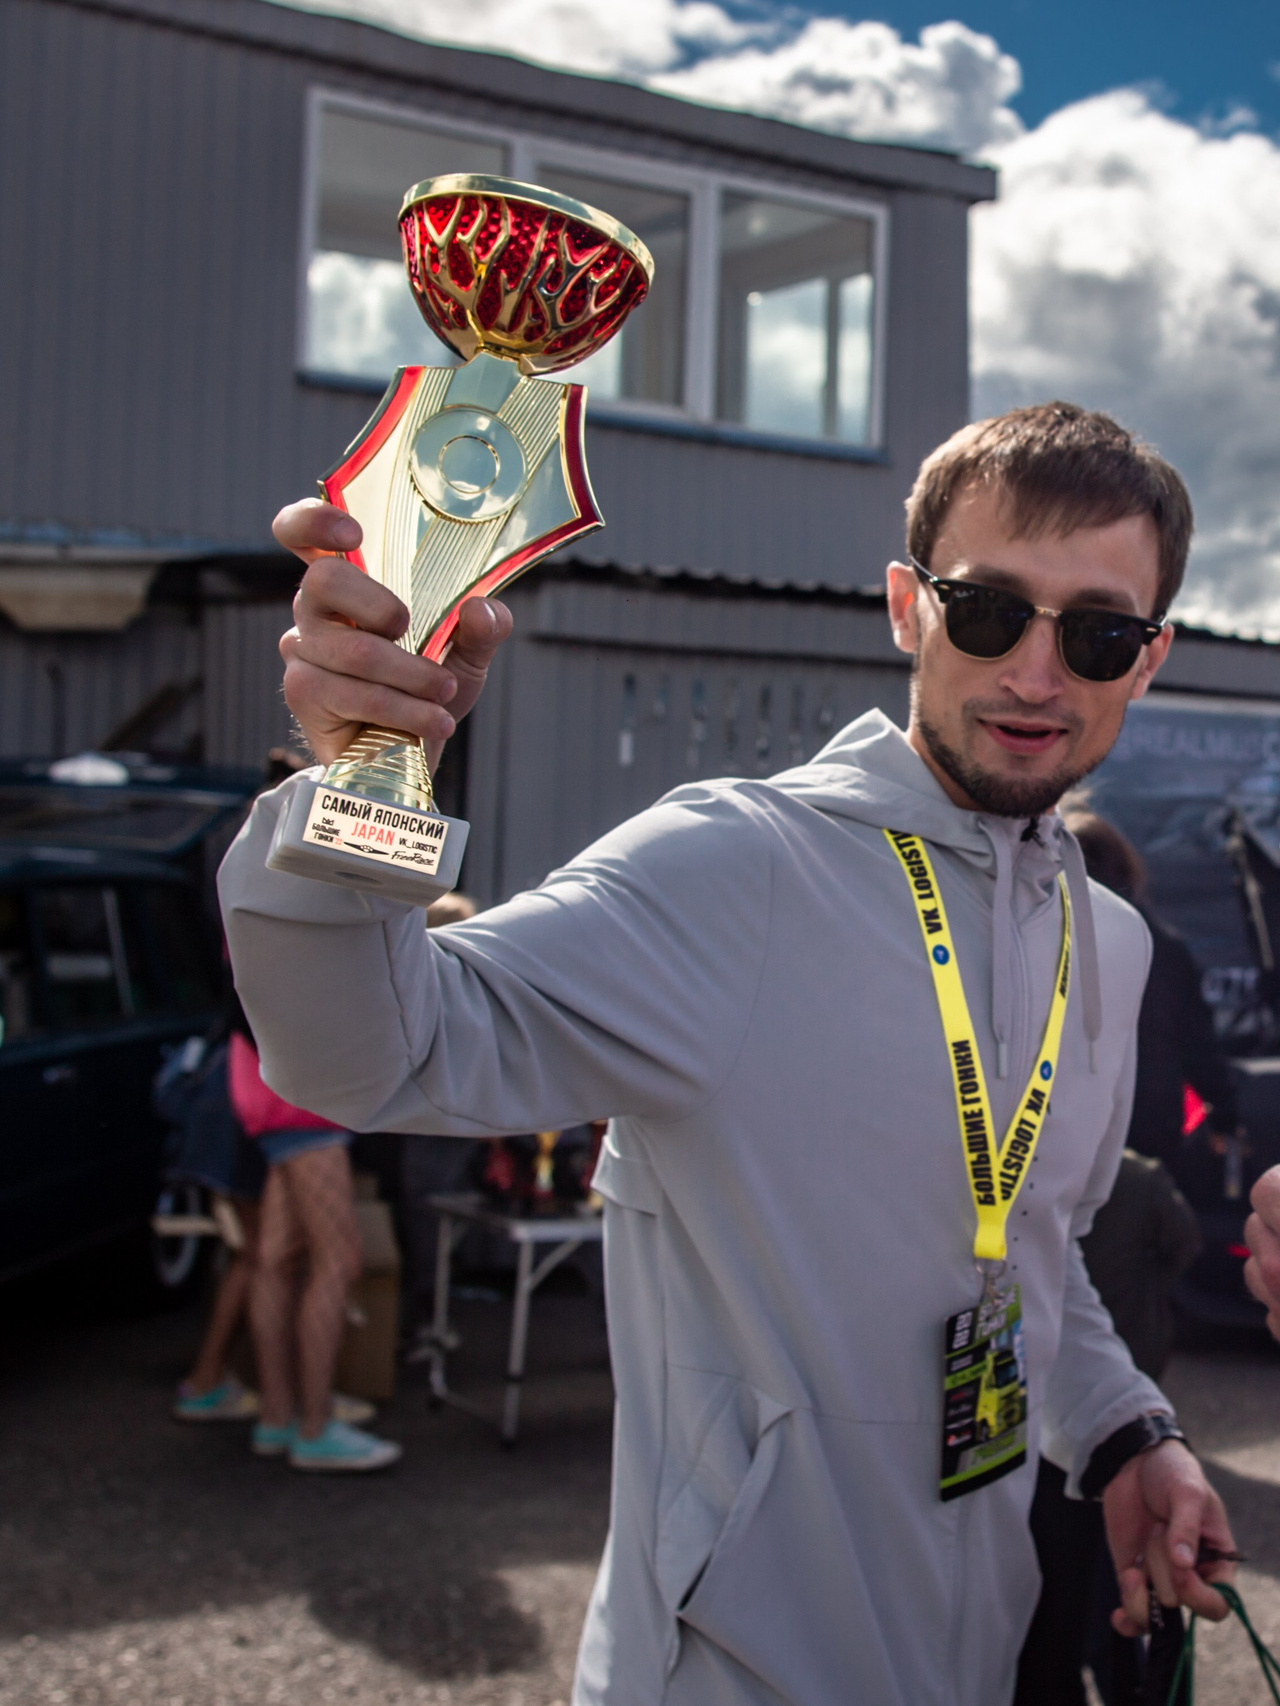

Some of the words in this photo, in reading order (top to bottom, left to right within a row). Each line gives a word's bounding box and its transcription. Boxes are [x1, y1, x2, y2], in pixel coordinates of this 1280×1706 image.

[321, 794, 372, 821] САМЫЙ
[373, 808, 445, 840] ЯПОНСКИЙ
[350, 821, 396, 846] JAPAN
[952, 1039, 981, 1106] ГОНКИ
[963, 1108, 996, 1206] БОЛЬШИЕ
